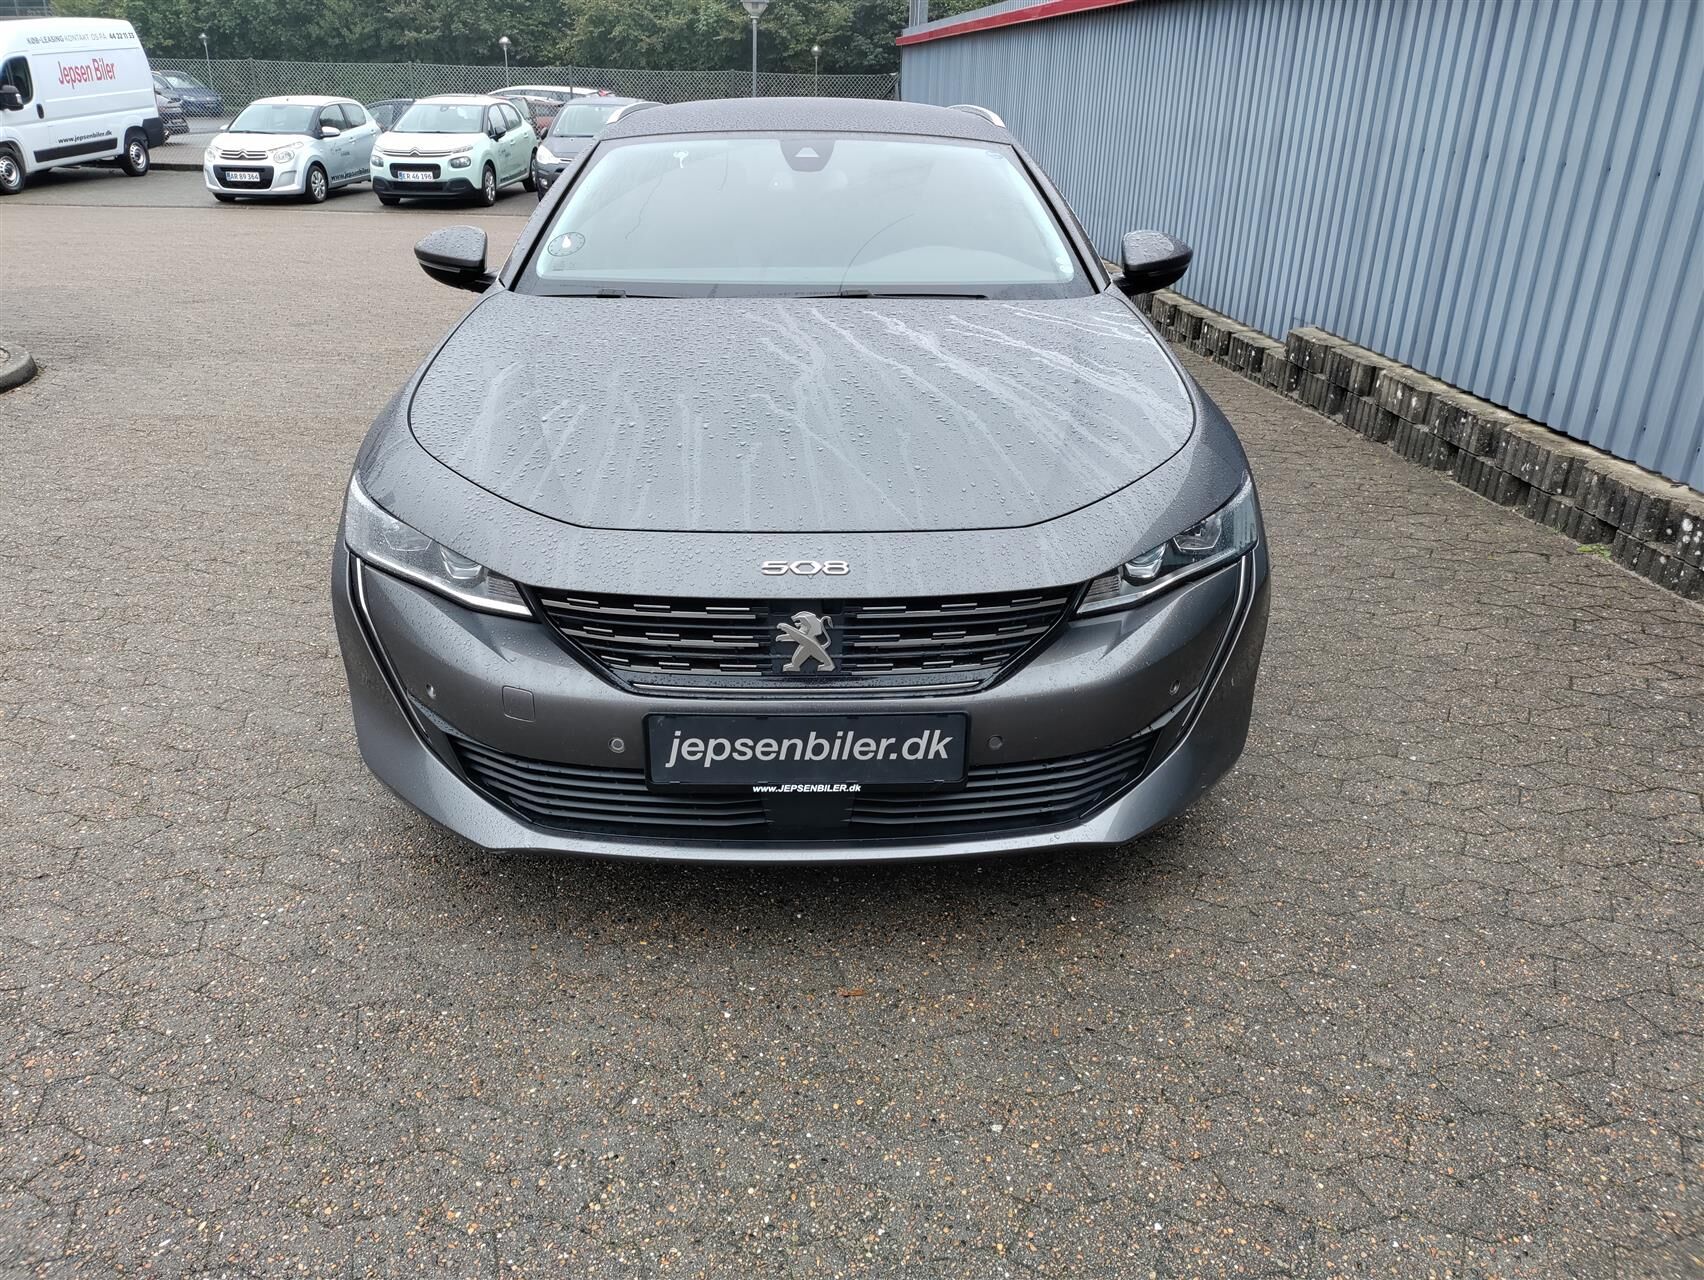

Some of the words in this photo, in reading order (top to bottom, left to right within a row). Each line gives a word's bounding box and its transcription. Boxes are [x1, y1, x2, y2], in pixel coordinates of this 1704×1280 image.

[58, 61, 93, 89] Jepsen
[92, 58, 116, 81] Biler
[58, 129, 112, 143] www.jepsenbiler.dk
[761, 560, 850, 575] 508
[665, 729, 953, 767] jepsenbiler.dk
[752, 783, 861, 793] www.JEPSENBILER.dk
